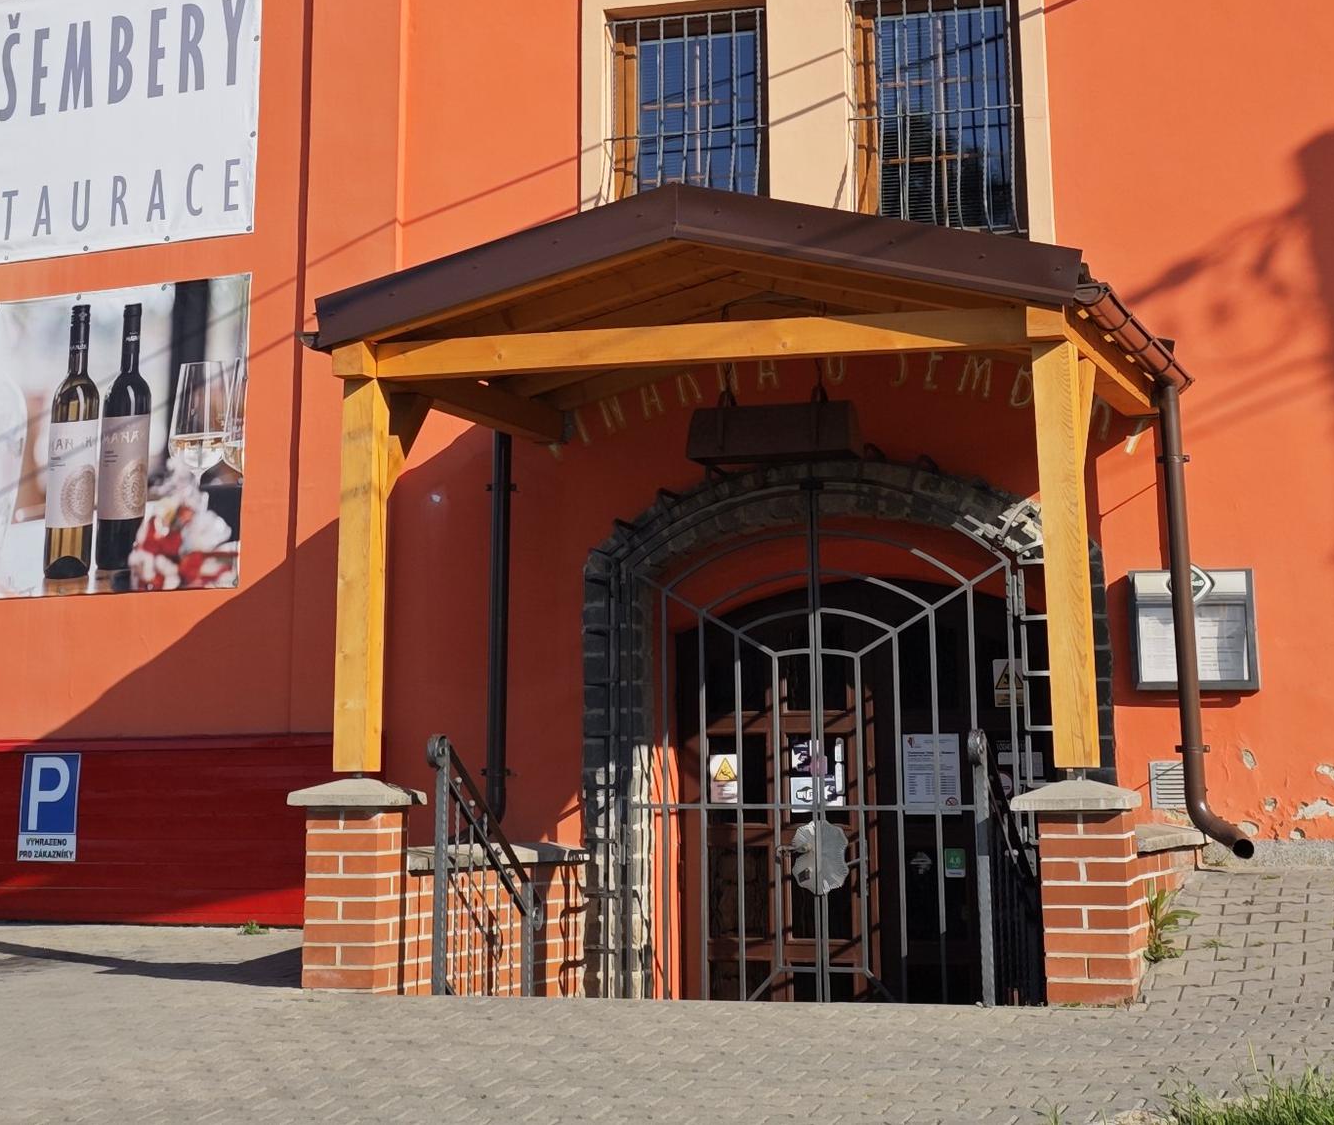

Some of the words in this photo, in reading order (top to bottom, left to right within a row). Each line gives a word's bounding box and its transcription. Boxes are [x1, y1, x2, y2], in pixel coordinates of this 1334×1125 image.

[28, 757, 70, 830] P
[26, 838, 68, 846] VYHRAZENO
[19, 851, 32, 859] PRO
[34, 849, 74, 859] ZÁKAZNÍKY
